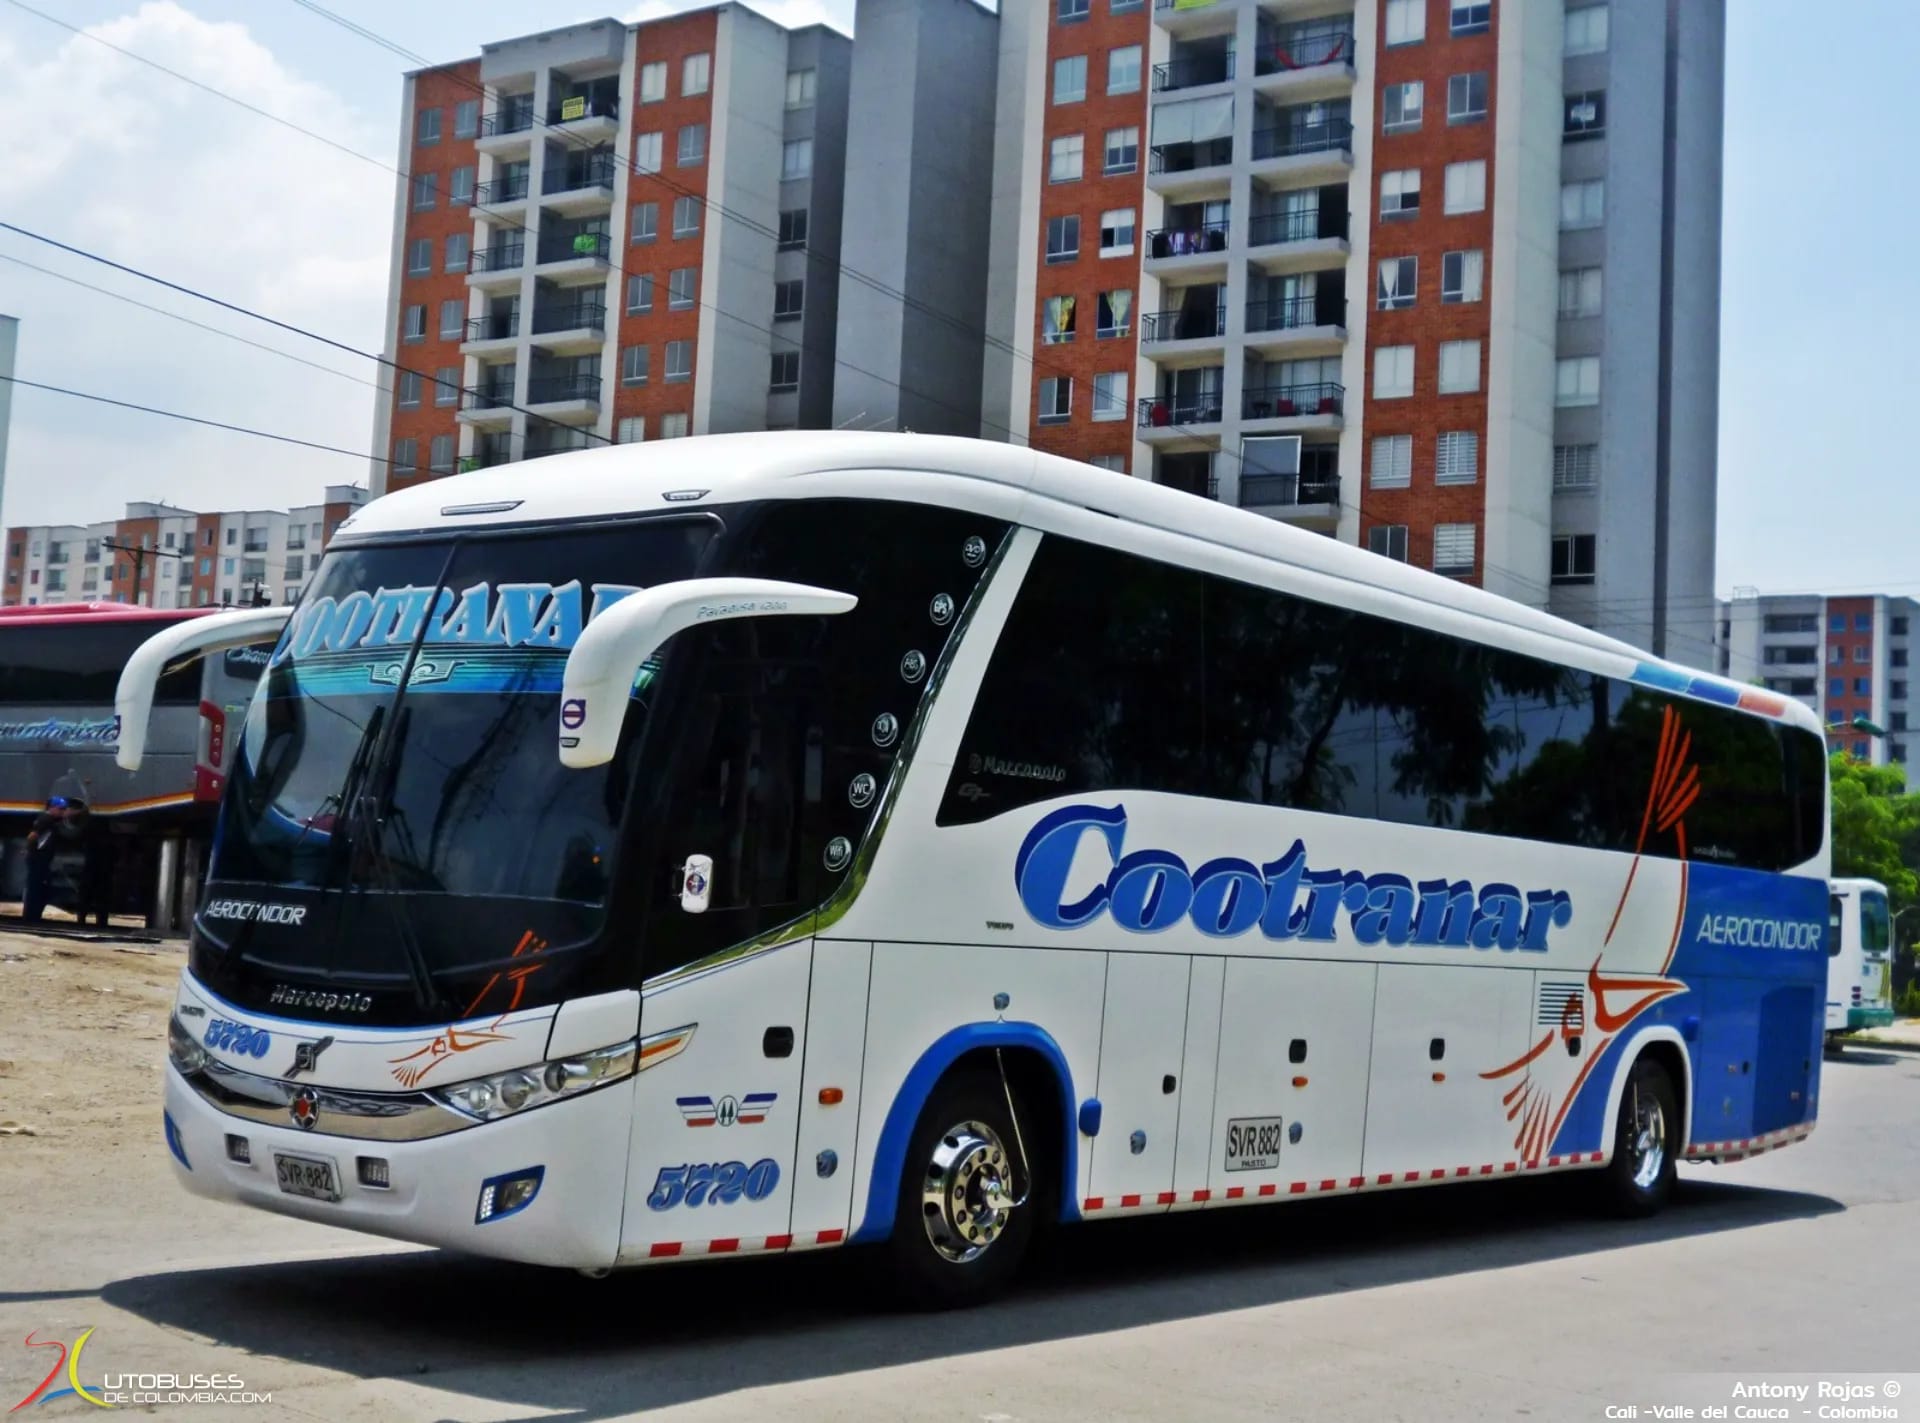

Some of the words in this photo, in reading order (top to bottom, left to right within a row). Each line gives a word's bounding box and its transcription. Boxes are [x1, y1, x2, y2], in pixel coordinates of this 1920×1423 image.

[853, 783, 871, 796] WC
[1015, 803, 1573, 954] Cootranar
[203, 900, 307, 926] AEROCNDOR
[1696, 912, 1822, 951] AEROCONDOR
[203, 1018, 272, 1060] 5720
[646, 1157, 781, 1212] 5720
